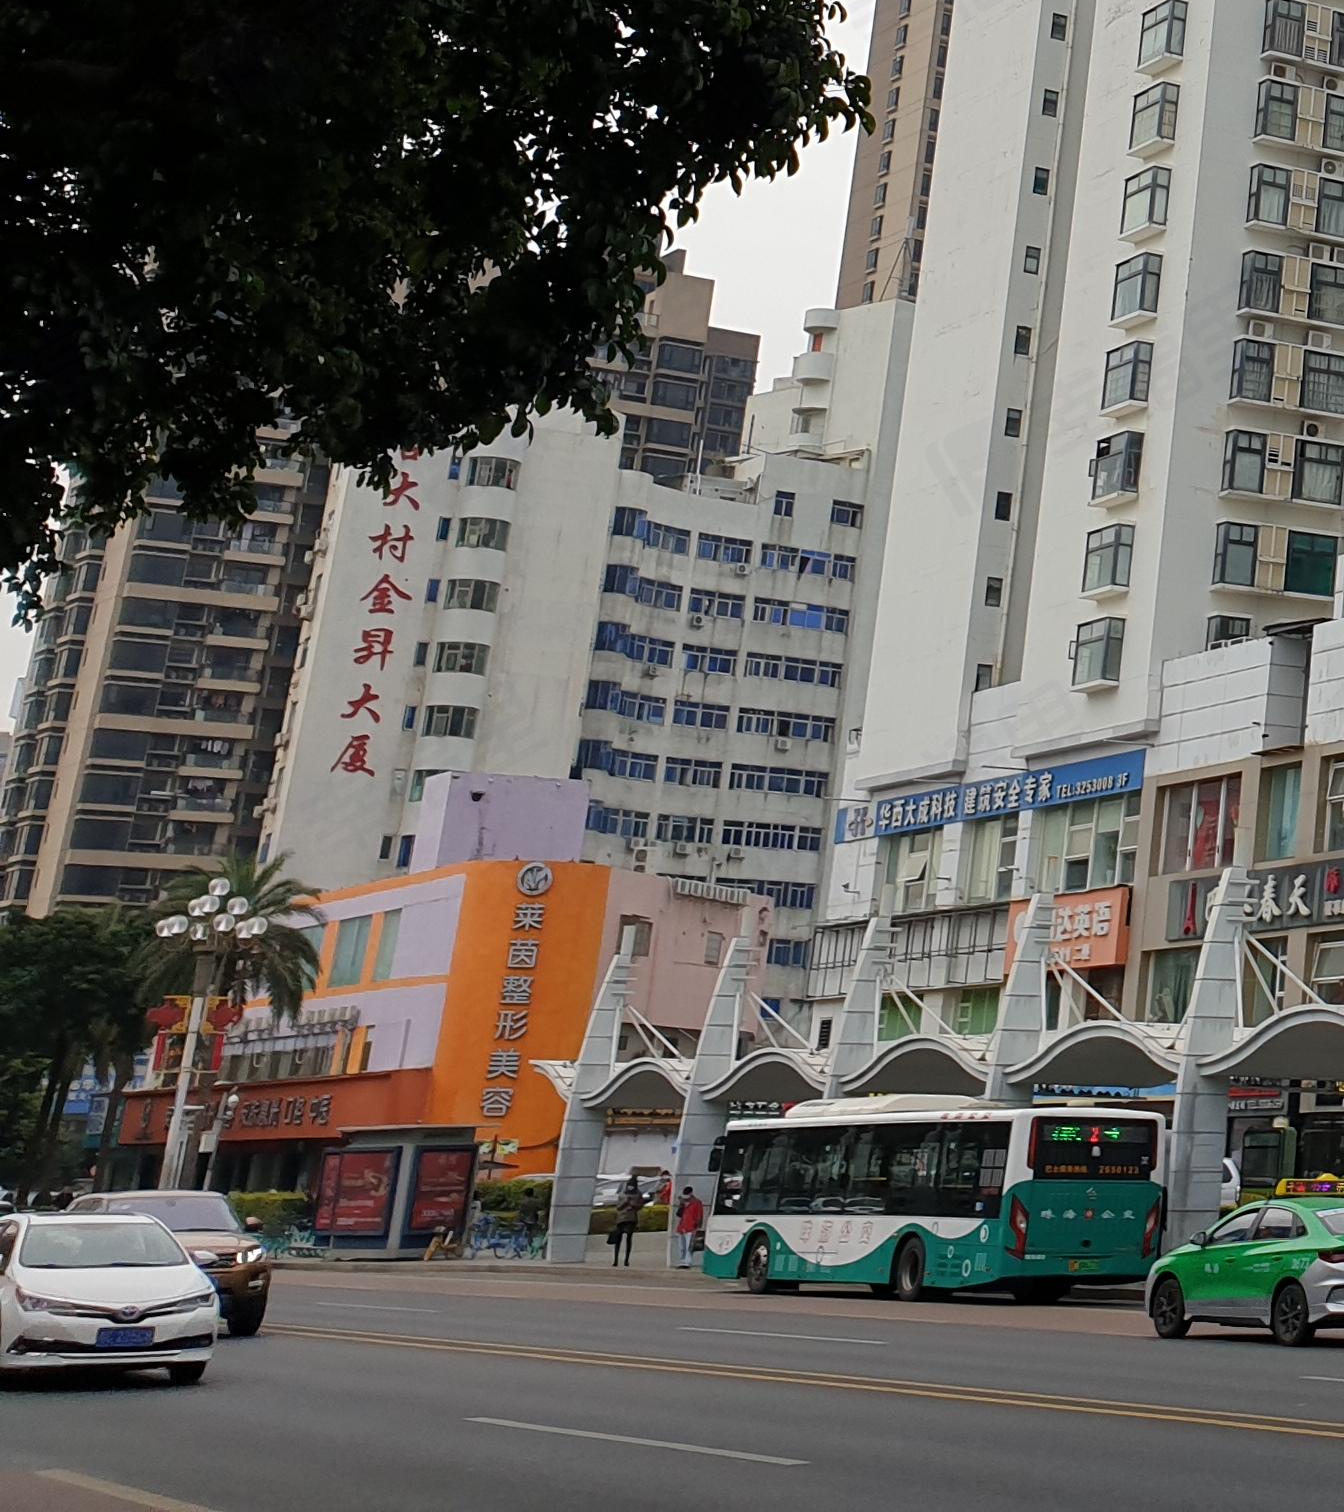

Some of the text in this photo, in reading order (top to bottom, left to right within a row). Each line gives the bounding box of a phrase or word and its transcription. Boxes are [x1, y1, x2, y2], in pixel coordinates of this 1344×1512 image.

[877, 788, 959, 831] 华西大成科技
[963, 772, 1054, 817] 建筑安全专家
[480, 902, 545, 1118] 莱茵整形美容
